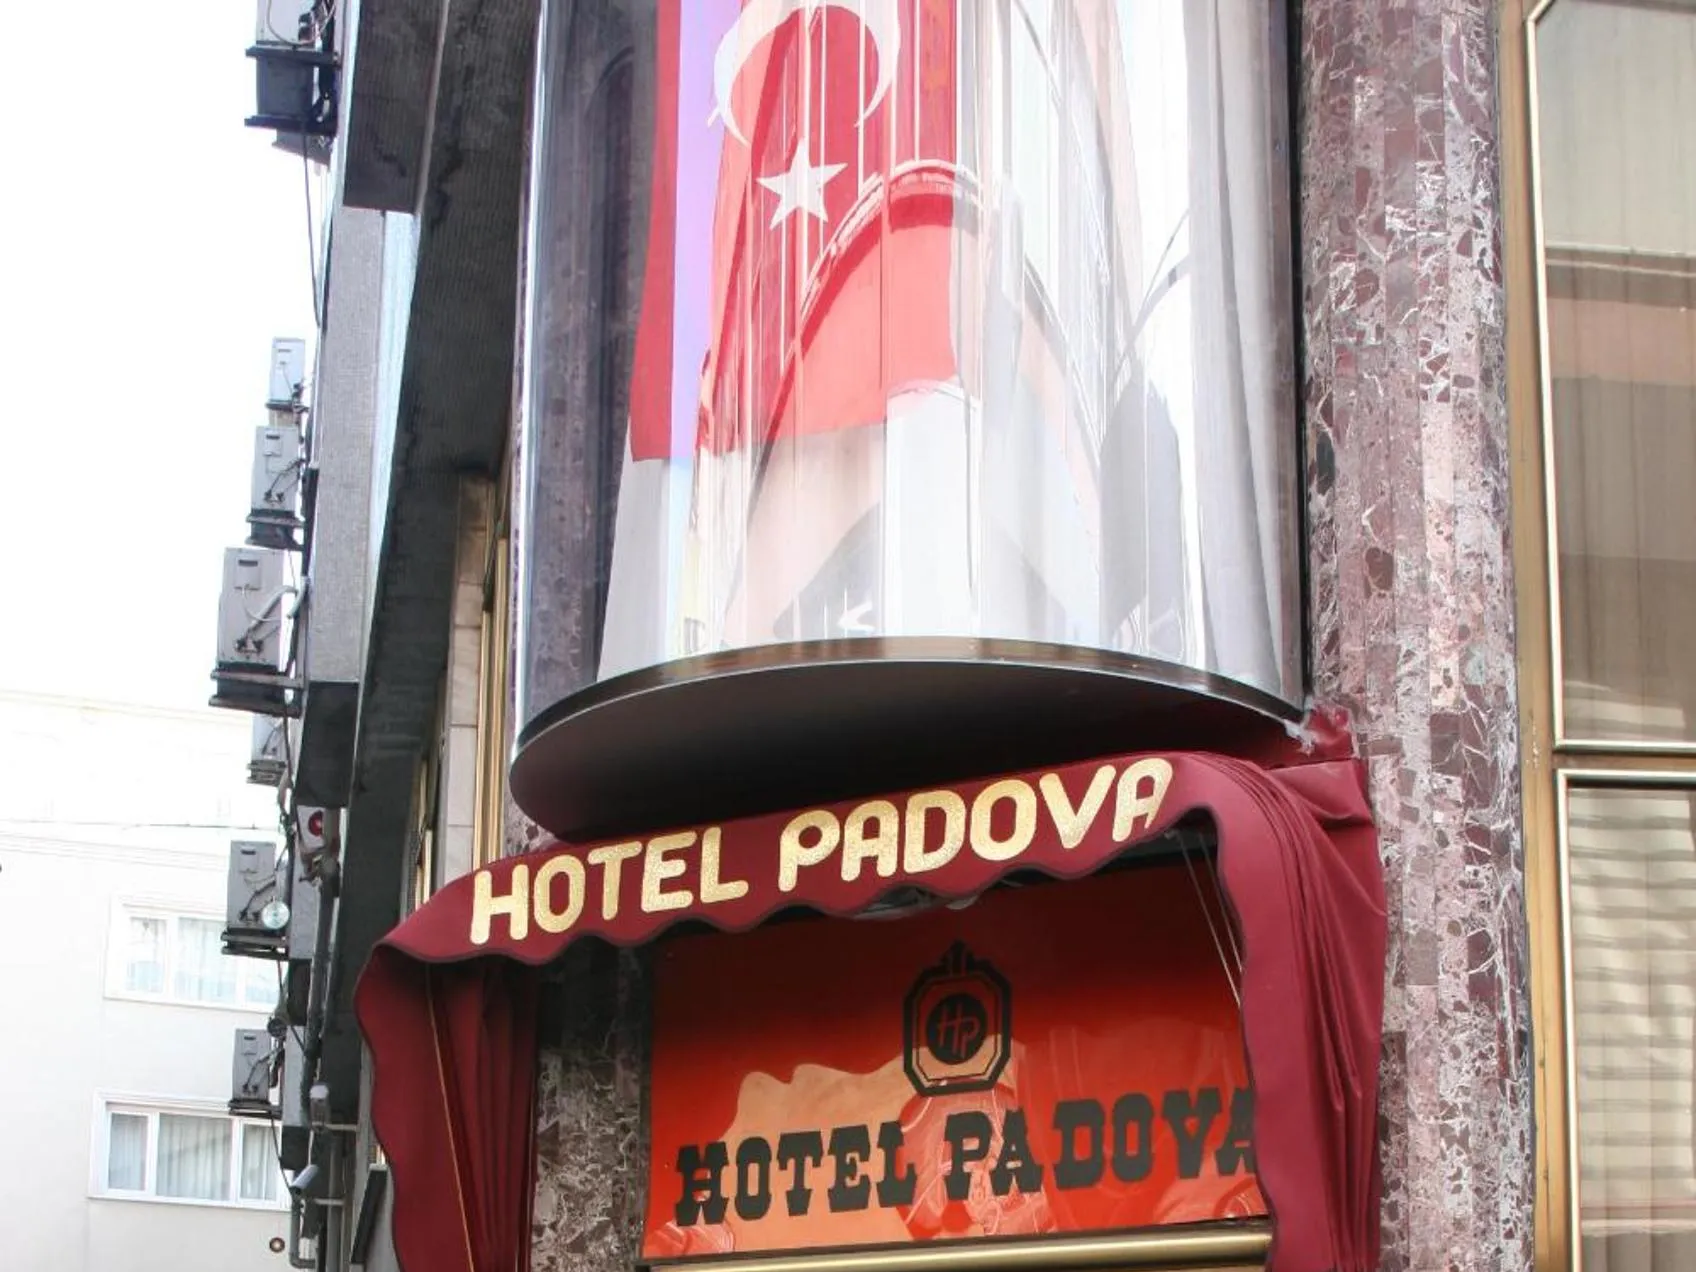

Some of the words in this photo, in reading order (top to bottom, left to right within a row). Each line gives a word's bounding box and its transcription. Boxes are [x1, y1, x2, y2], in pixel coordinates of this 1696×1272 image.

[469, 826, 748, 945] HOTEL
[778, 757, 1173, 893] PADOVA
[675, 1120, 918, 1226] HOTEL
[944, 1087, 1256, 1200] PADOVA
